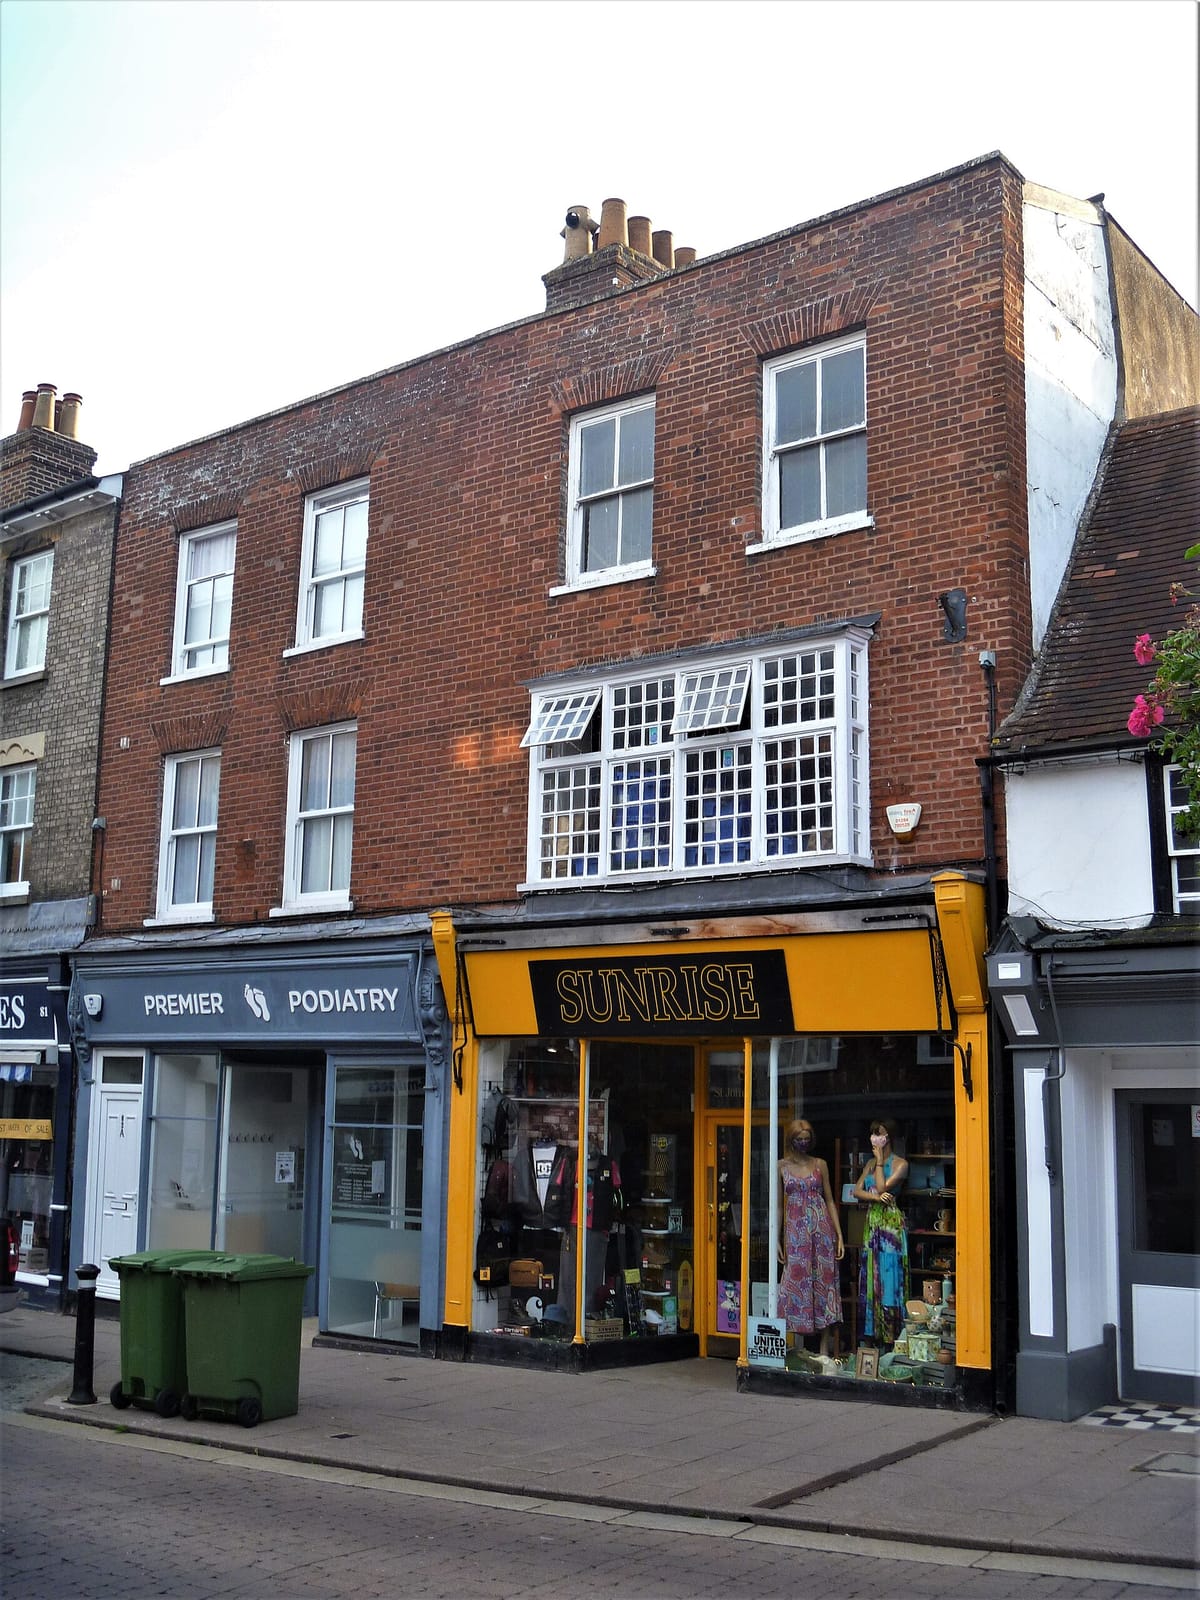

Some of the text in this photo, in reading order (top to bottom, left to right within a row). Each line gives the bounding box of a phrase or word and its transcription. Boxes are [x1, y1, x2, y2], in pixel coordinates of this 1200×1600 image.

[556, 963, 760, 1023] SUNRISE
[144, 988, 399, 1016] PREMIER PODIATRY
[36, 1124, 49, 1133] SALE
[754, 1336, 785, 1347] UNITED
[758, 1346, 785, 1357] SKATE
